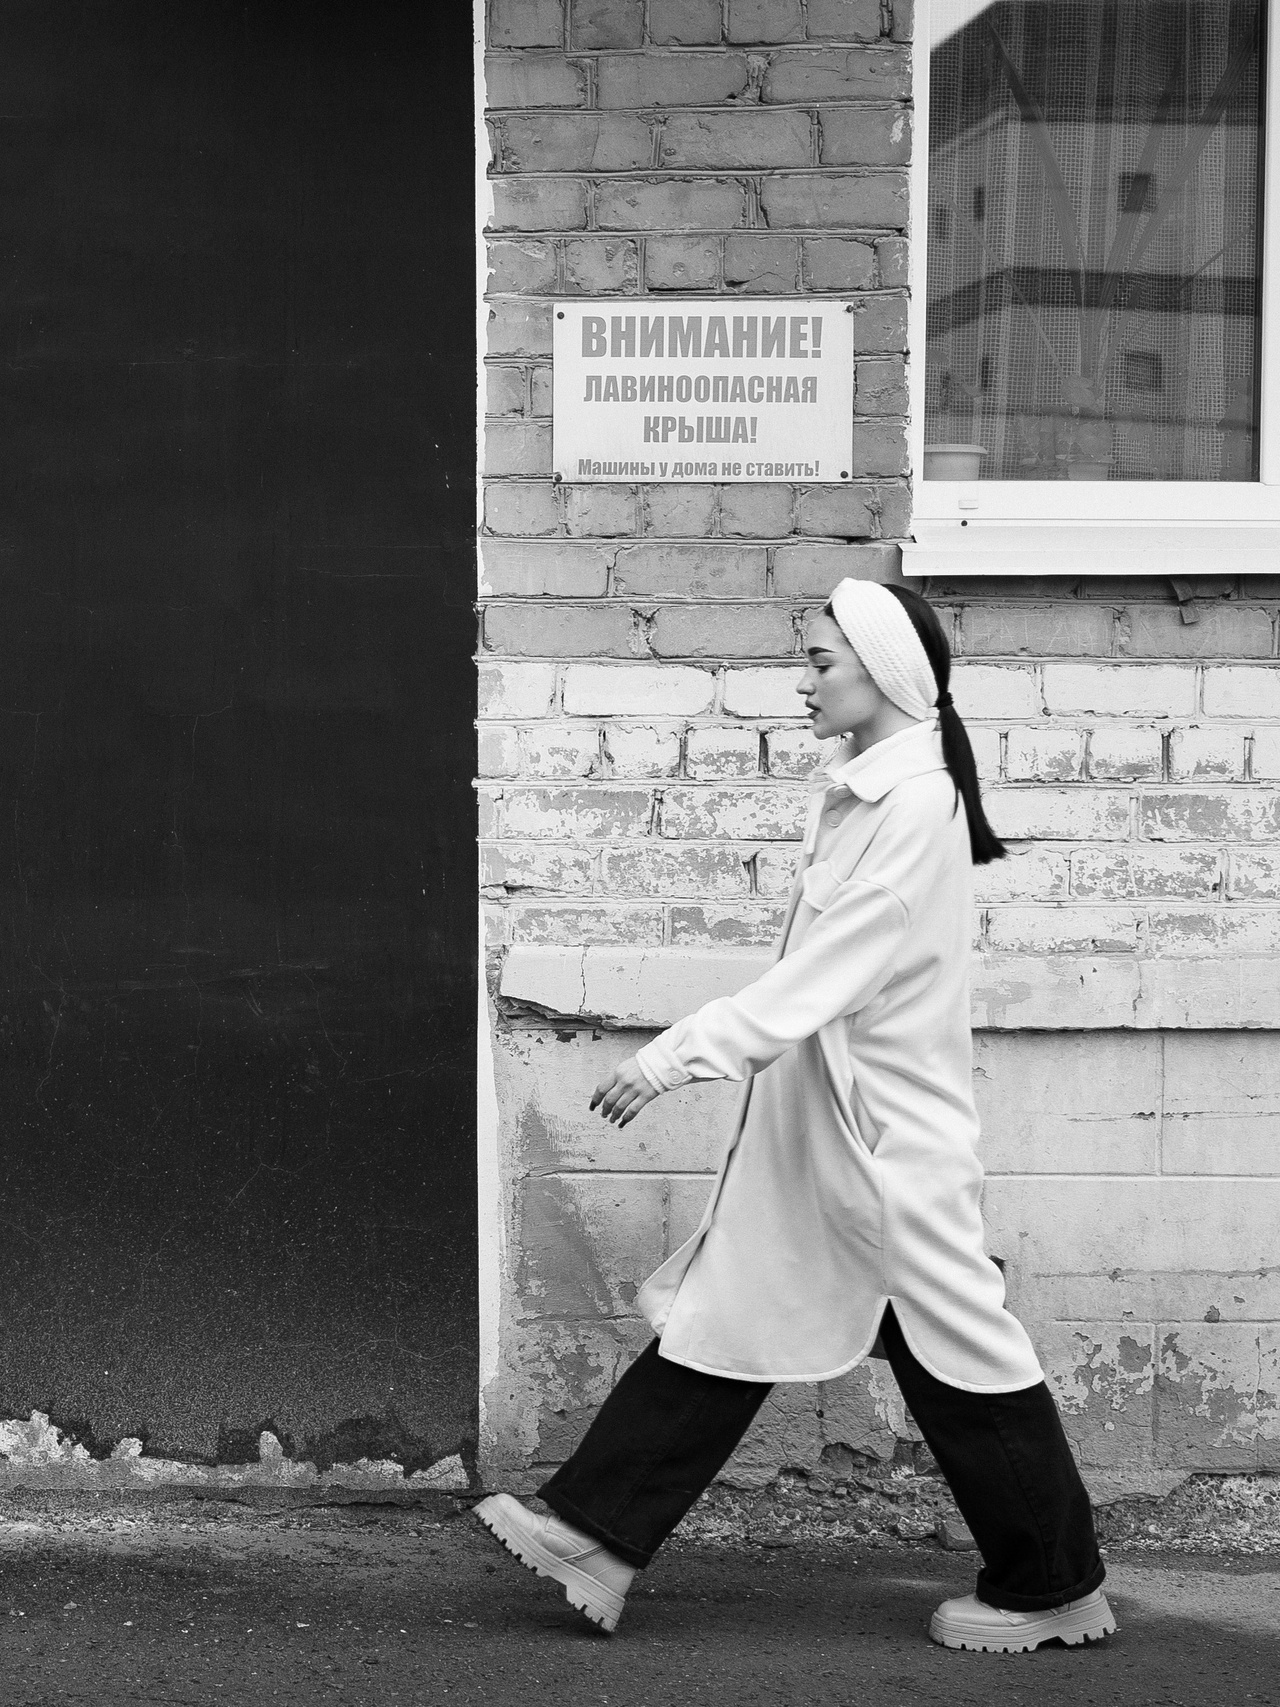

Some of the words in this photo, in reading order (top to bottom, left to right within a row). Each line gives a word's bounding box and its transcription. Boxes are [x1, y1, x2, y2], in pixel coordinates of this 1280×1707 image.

[581, 315, 823, 358] ВНИМАНИЕ!
[583, 375, 818, 403] ЛАВИНООПАСНАЯ
[643, 416, 758, 443] КРЫША!
[577, 459, 656, 476] Машины
[659, 462, 668, 478] у
[671, 462, 718, 478] дома
[721, 462, 742, 476] не
[745, 460, 820, 477] ставить!
